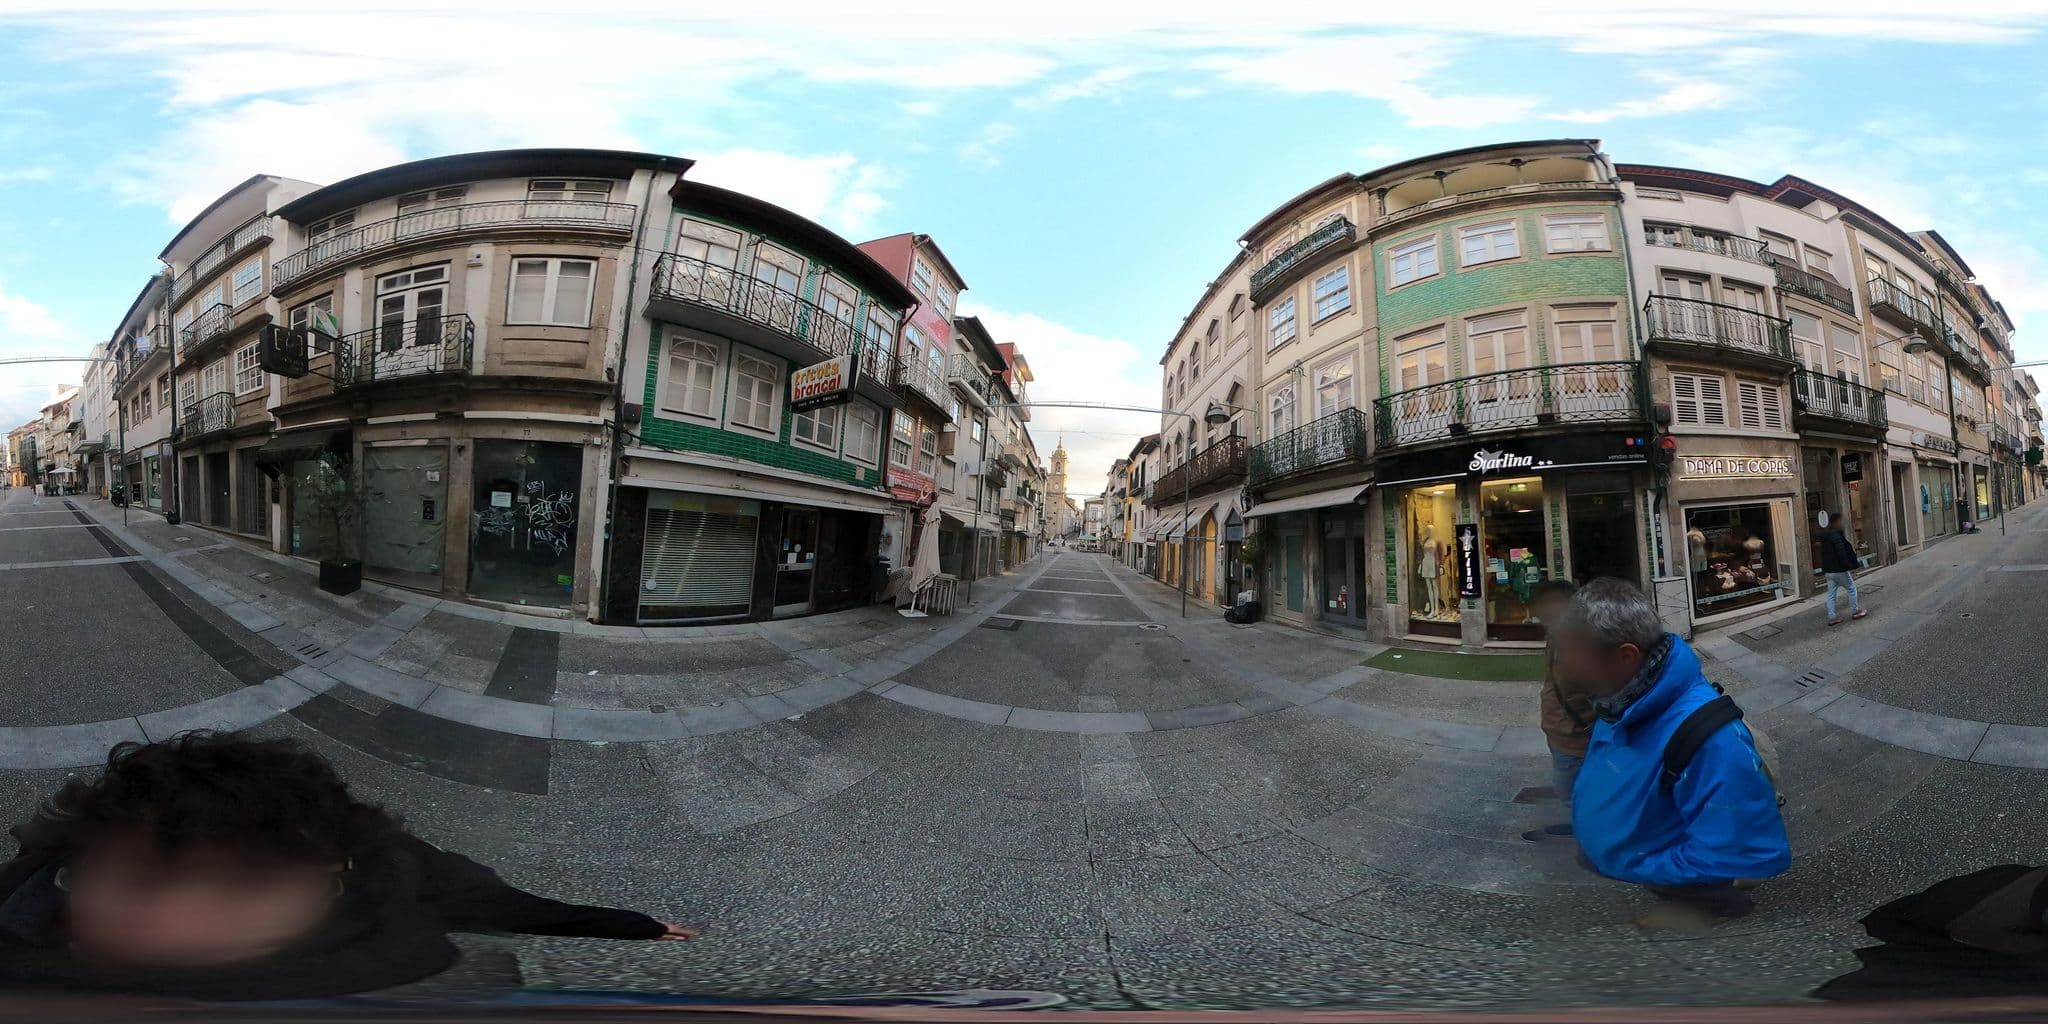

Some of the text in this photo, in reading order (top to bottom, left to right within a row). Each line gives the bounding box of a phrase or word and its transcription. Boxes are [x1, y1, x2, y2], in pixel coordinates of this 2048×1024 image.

[795, 374, 841, 399] brancal
[1469, 450, 1533, 471] Starlina
[1685, 460, 1789, 474] DAMA DE COPAS
